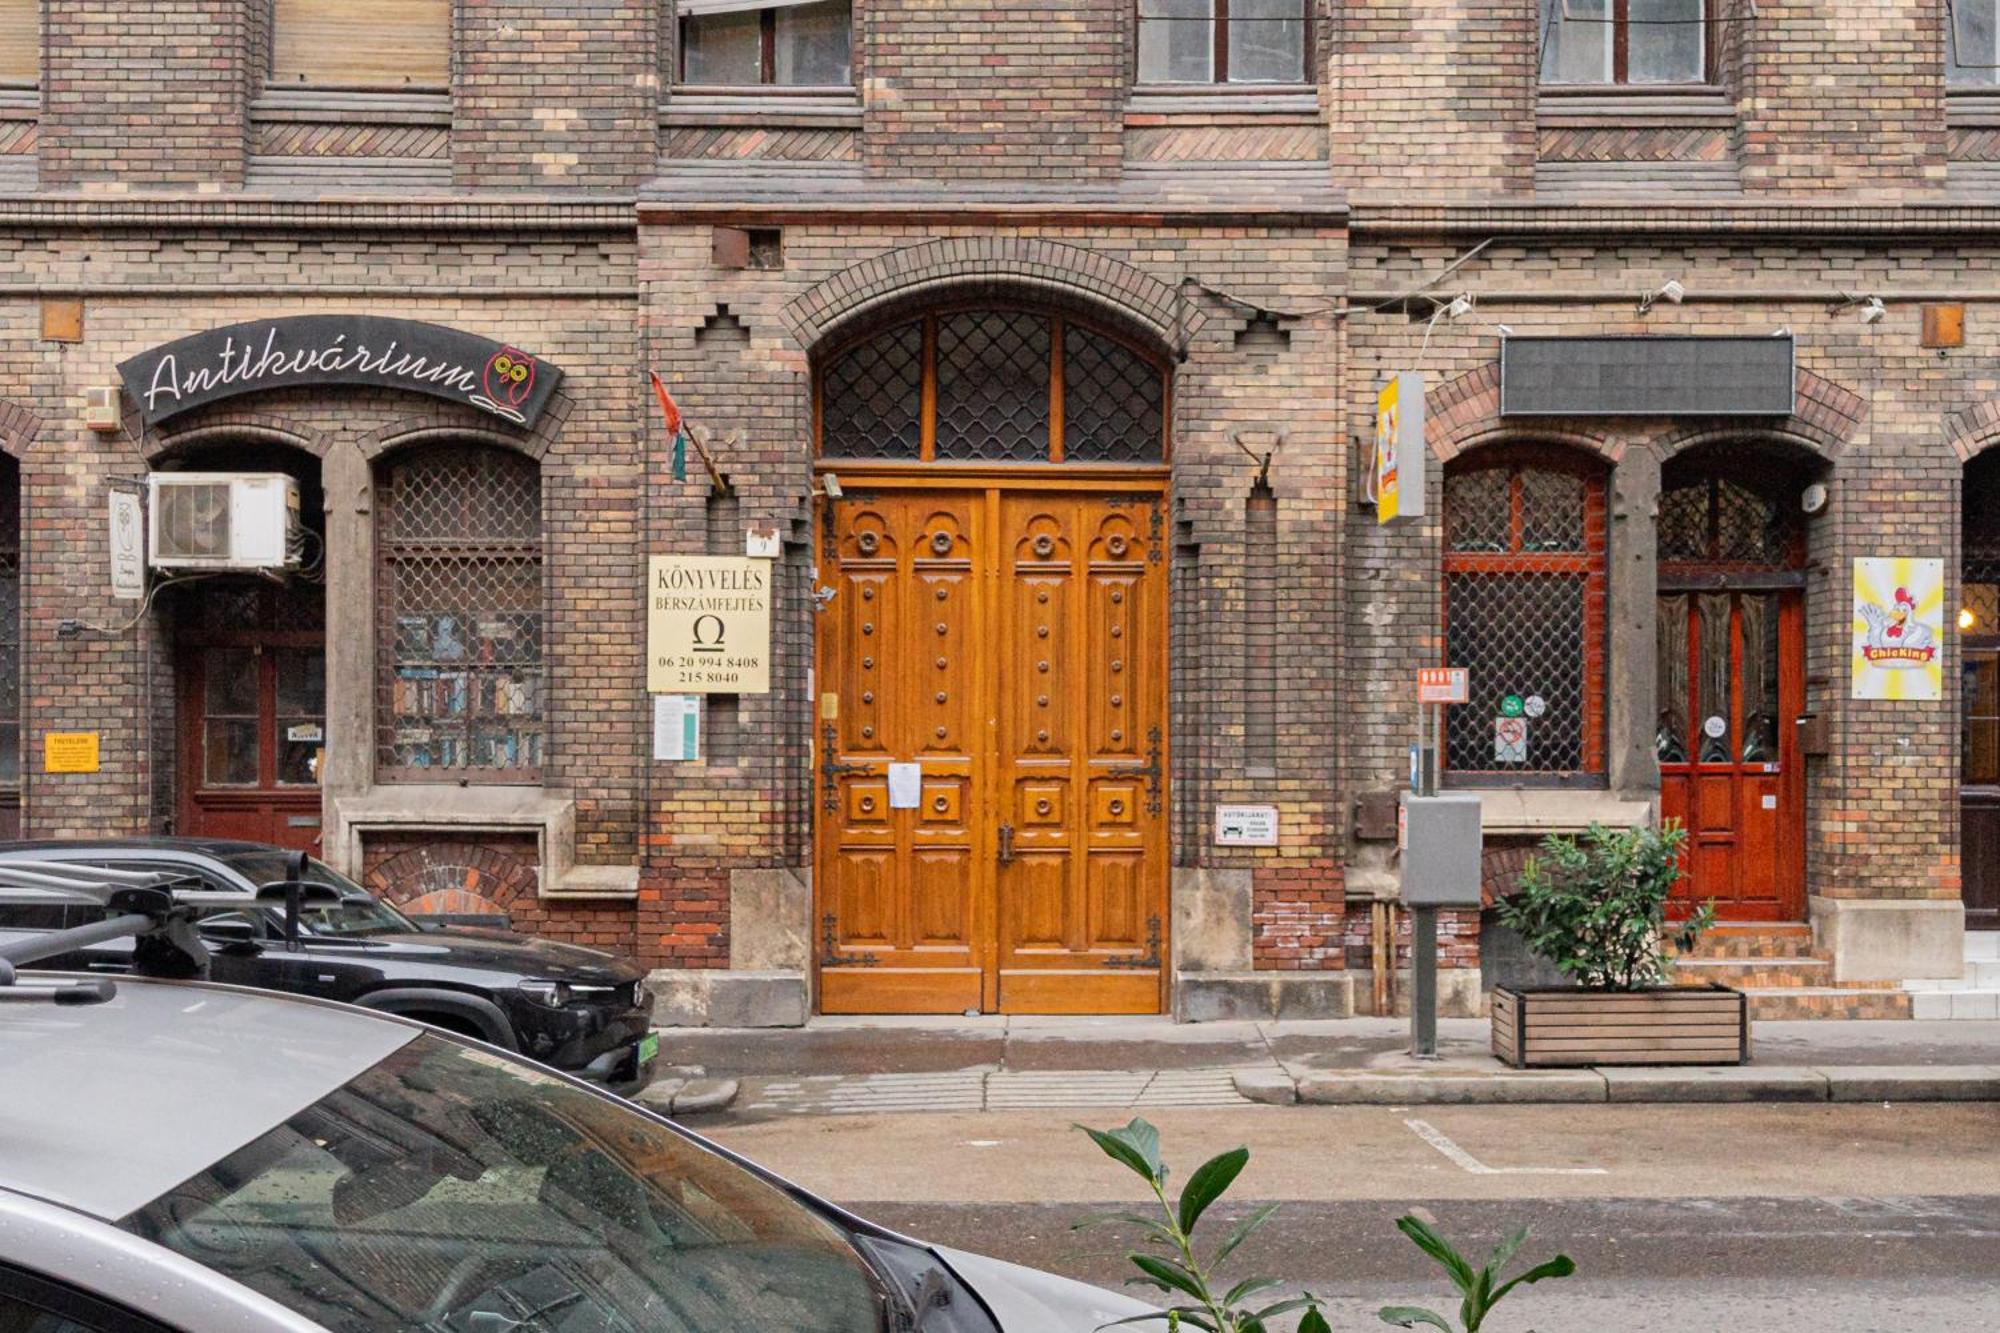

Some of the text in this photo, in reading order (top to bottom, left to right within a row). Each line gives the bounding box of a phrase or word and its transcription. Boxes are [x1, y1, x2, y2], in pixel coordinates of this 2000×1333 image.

[143, 327, 476, 411] Antikvárium
[657, 564, 763, 591] KÖNYVELÉS
[1870, 648, 1928, 661] ChicKing
[658, 656, 759, 669] 06 20 994 8408
[679, 672, 739, 684] 215 8040
